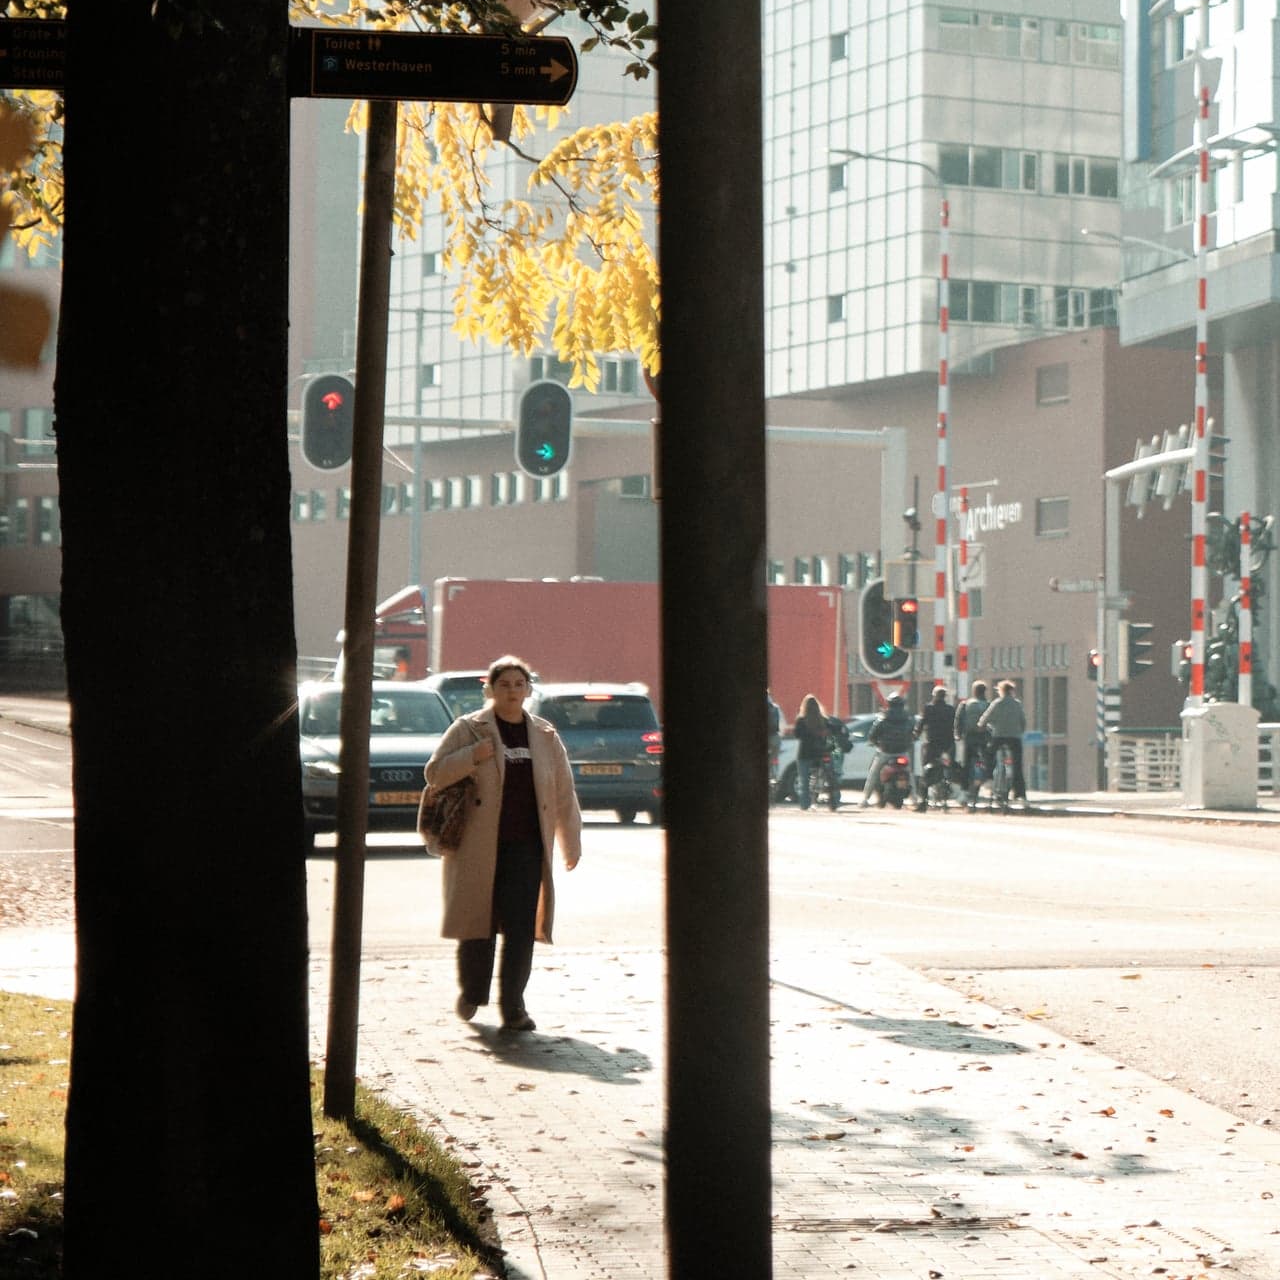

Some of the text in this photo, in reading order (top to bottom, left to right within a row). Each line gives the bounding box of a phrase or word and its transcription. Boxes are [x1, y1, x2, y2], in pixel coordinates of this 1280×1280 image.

[323, 36, 362, 51] Toilet
[500, 43, 537, 57] 5 min
[344, 58, 433, 74] Westerhaven
[500, 62, 536, 76] 5 min
[966, 492, 1022, 541] Archieven
